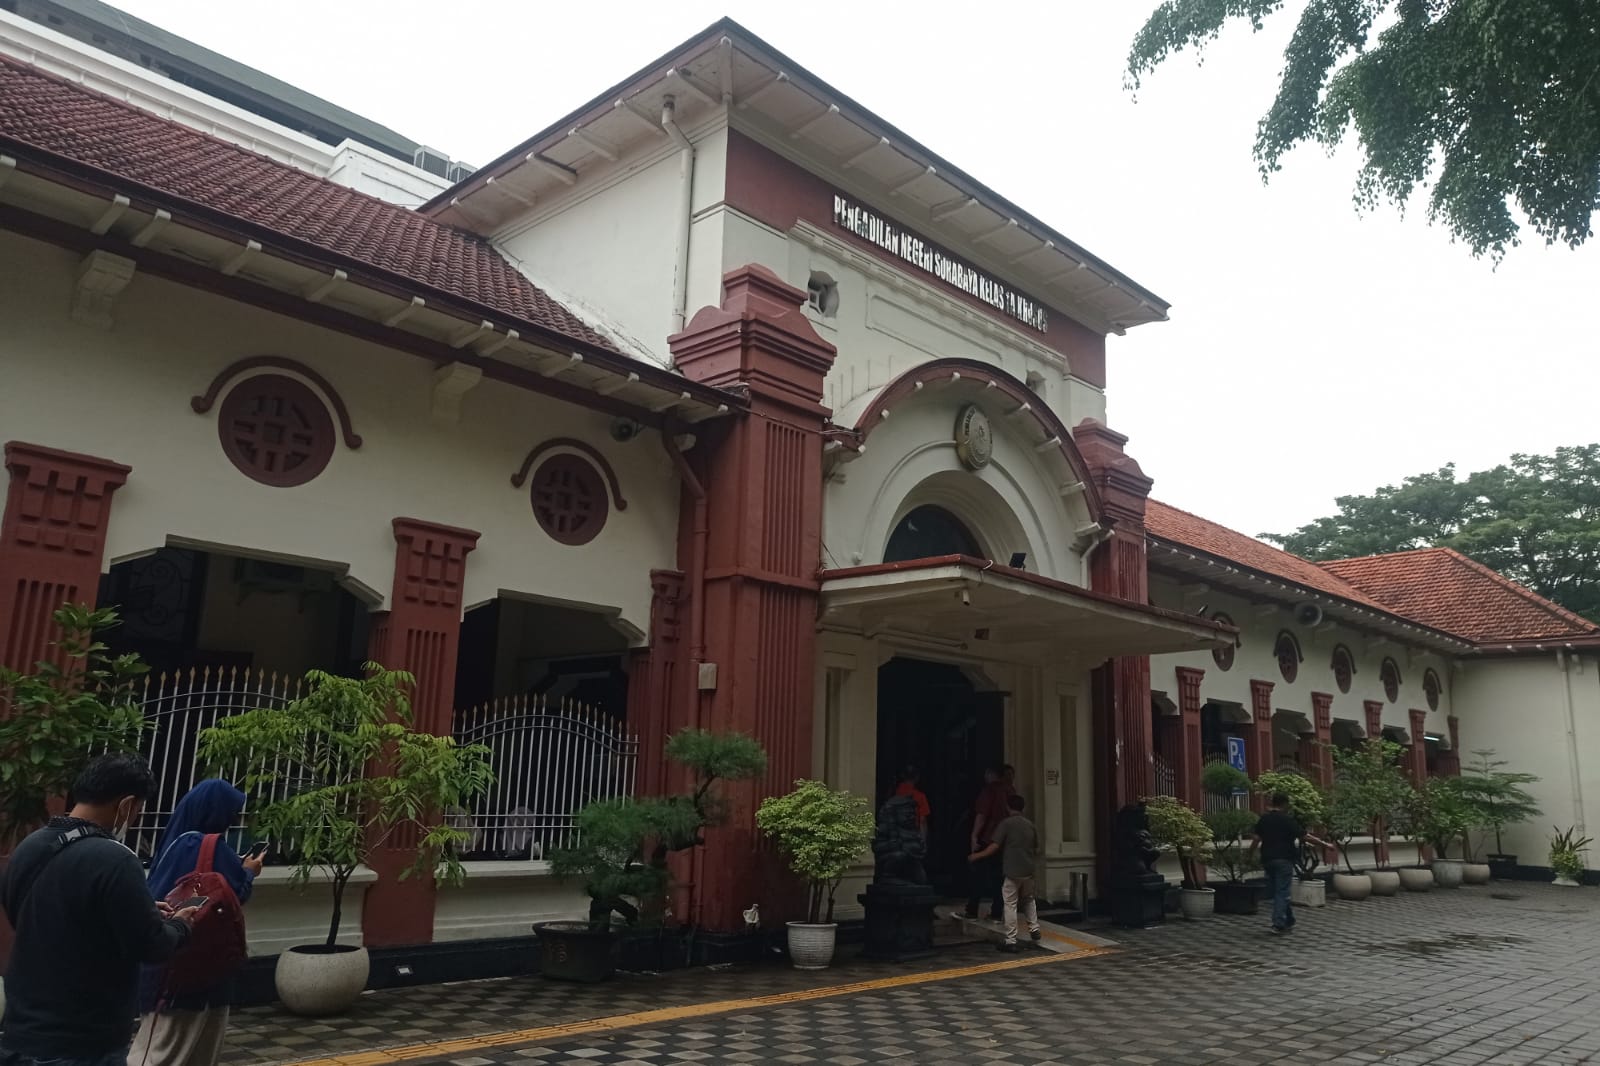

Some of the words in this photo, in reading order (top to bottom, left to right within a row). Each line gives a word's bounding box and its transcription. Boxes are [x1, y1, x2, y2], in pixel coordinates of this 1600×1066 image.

[834, 194, 899, 255] PENGADILAN
[900, 232, 933, 273] NEGERI
[934, 252, 979, 298] SURABAYA
[979, 275, 1005, 310] KELAS
[1017, 295, 1049, 333] KHUSUS
[1230, 741, 1238, 764] P
